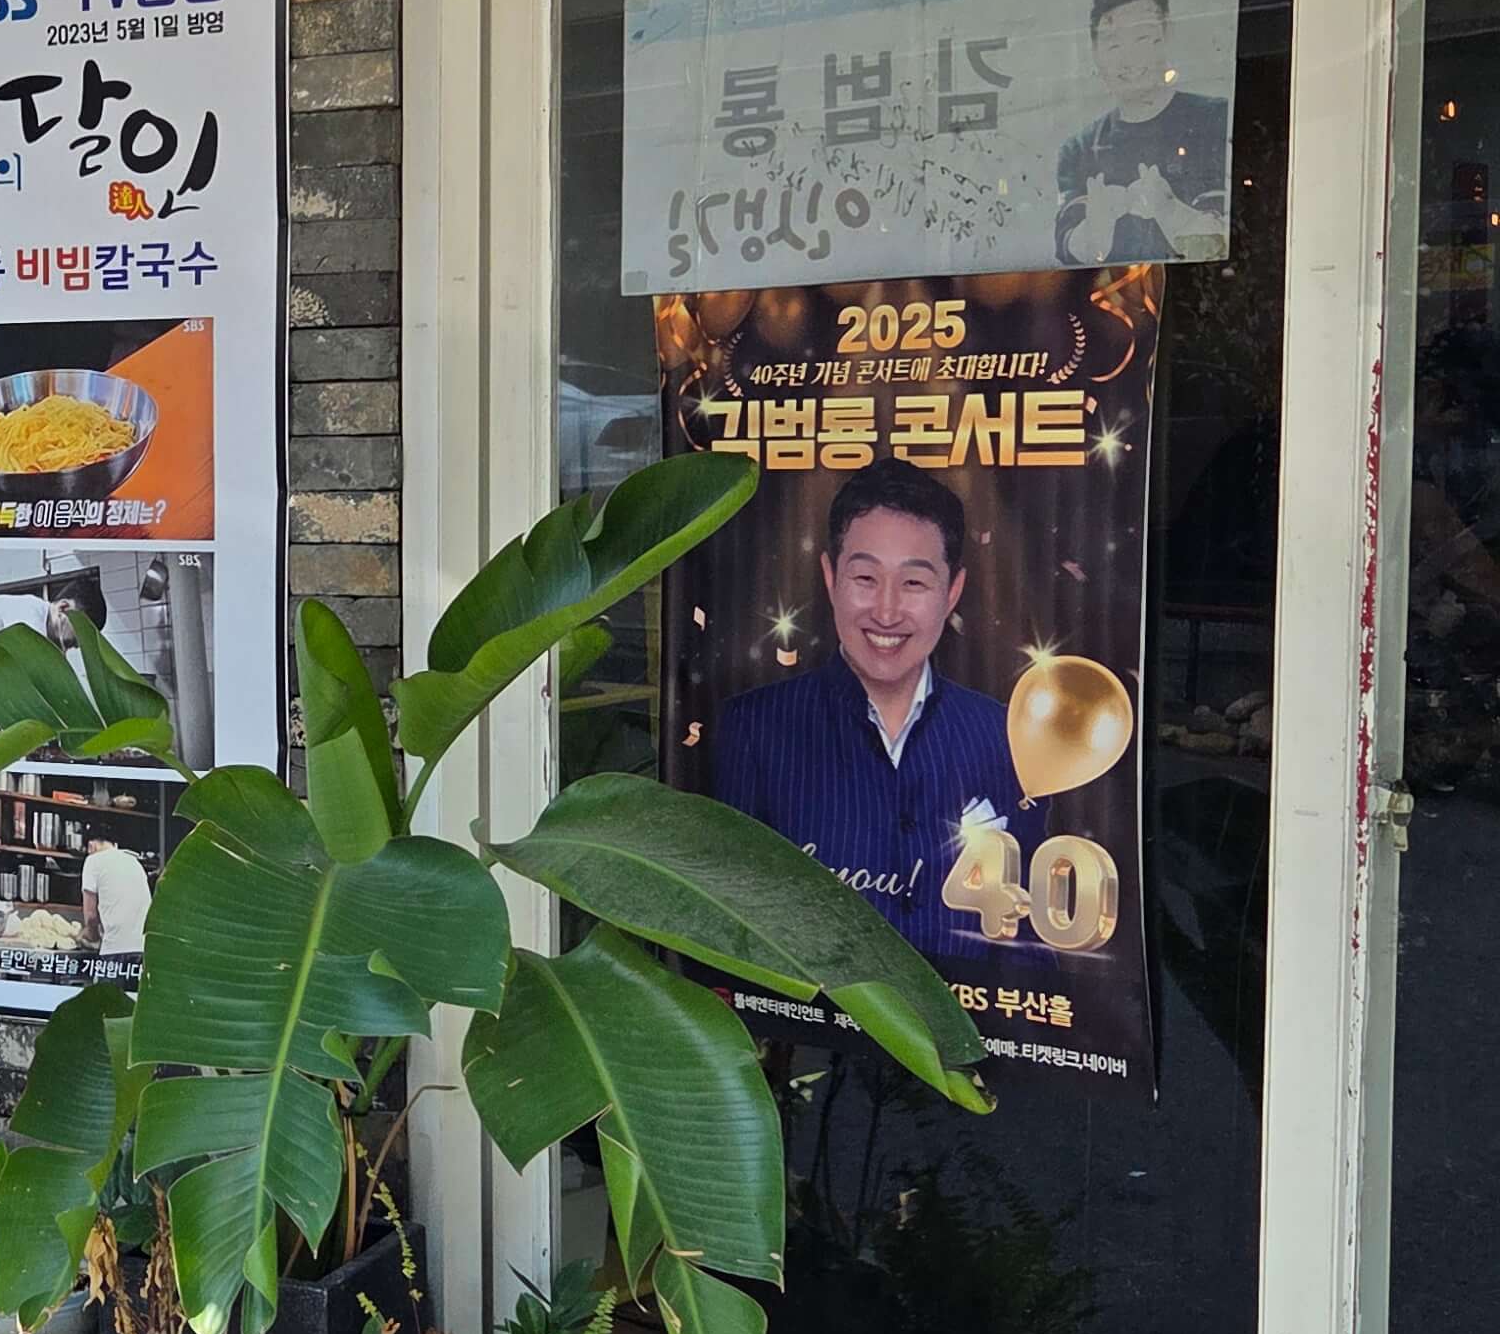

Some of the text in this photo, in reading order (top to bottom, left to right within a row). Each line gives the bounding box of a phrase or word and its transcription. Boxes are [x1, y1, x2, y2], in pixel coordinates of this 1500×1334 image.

[47, 10, 224, 47] 2023년 5월 1일 방영
[110, 182, 152, 219] 達人
[183, 319, 205, 332] SBS
[836, 299, 967, 354] 2025
[750, 351, 1049, 387] 40주년 기념 콘서트에 초대합니다!
[705, 390, 1085, 470] 김범룡 콘서트
[33, 500, 51, 528] 이
[106, 499, 167, 526] 정체는?
[178, 554, 201, 567] SBS
[941, 830, 1120, 951] 40
[995, 987, 1074, 1028] 부산홀
